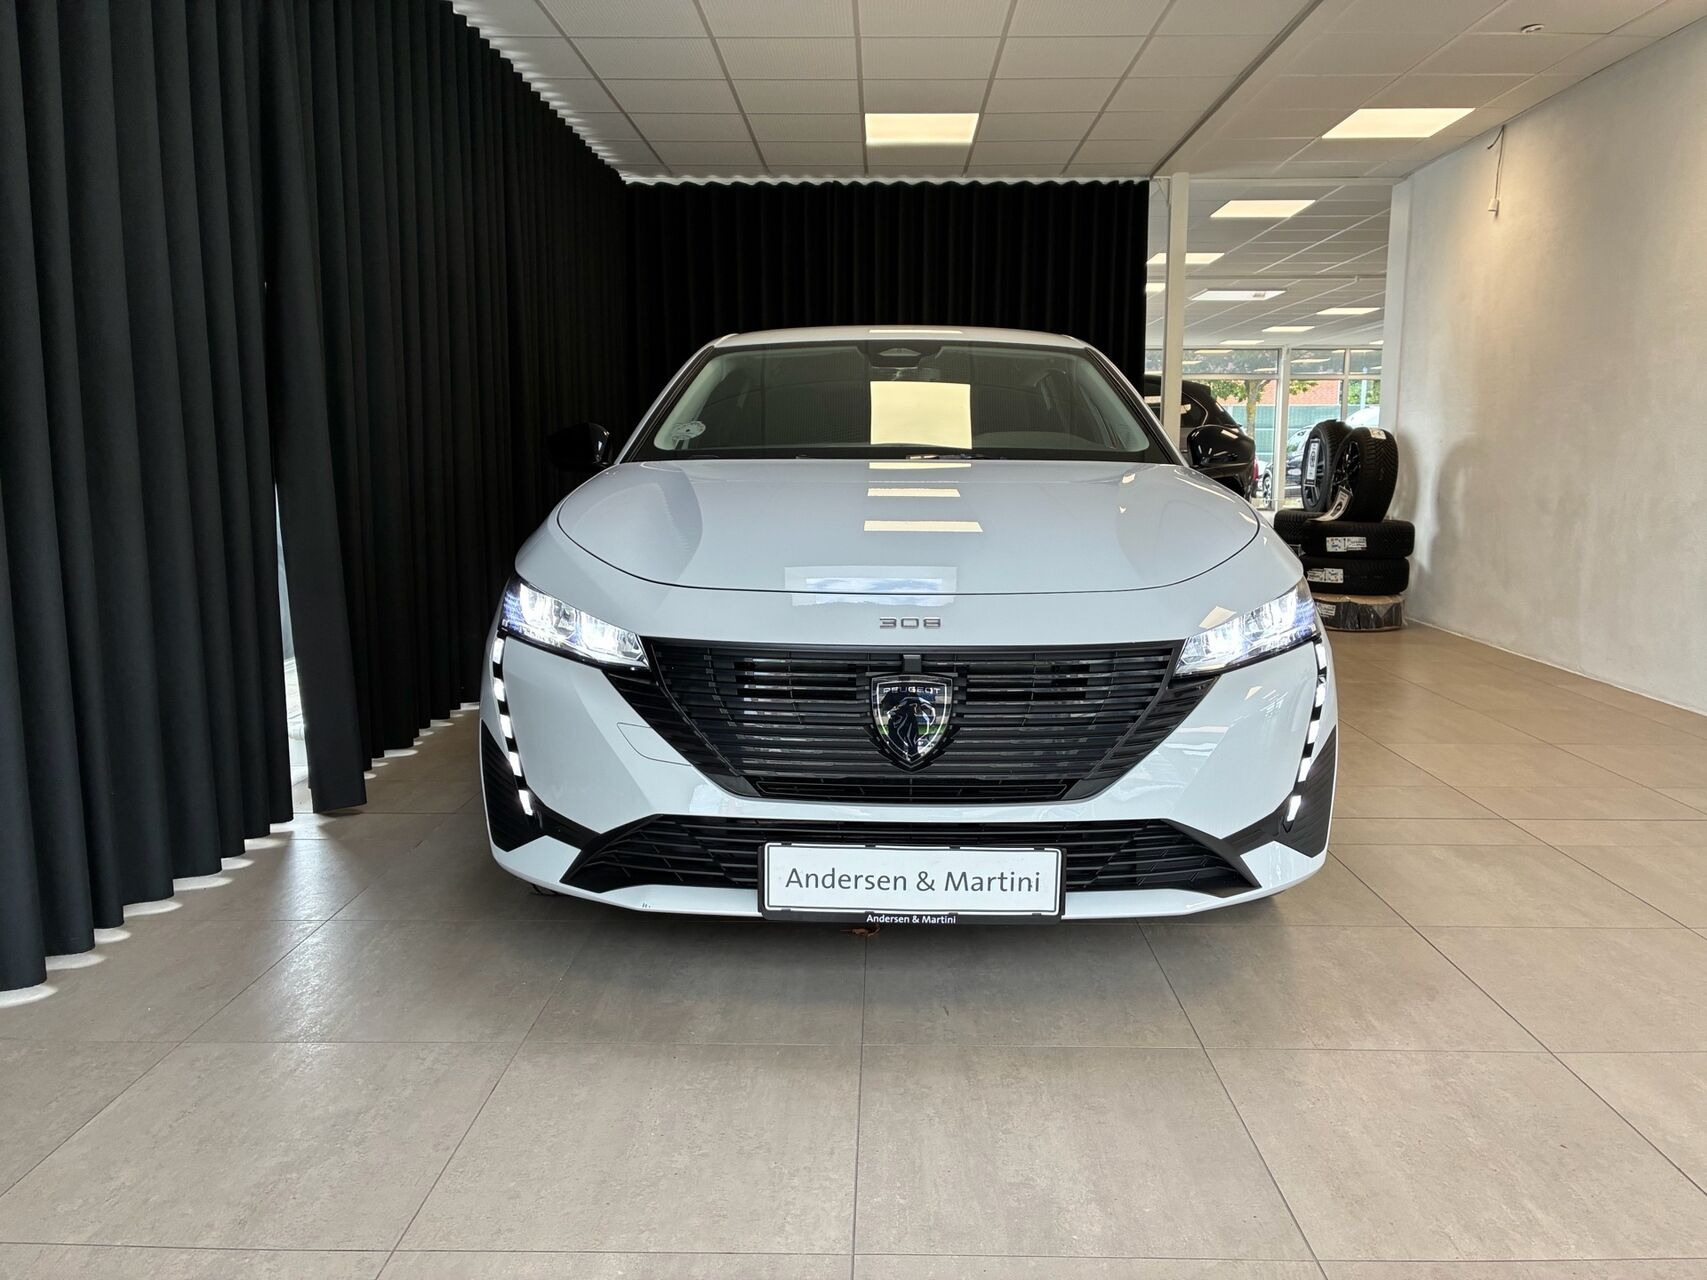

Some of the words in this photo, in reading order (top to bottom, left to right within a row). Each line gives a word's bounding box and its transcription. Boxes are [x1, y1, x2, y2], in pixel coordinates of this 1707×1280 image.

[879, 617, 941, 629] 308
[883, 686, 941, 694] PEUGEOT
[785, 868, 907, 892] Andersen
[916, 871, 935, 891] &
[944, 871, 1040, 892] Martini
[866, 914, 910, 923] Andersen
[912, 915, 920, 923] &
[921, 915, 956, 924] Martini
